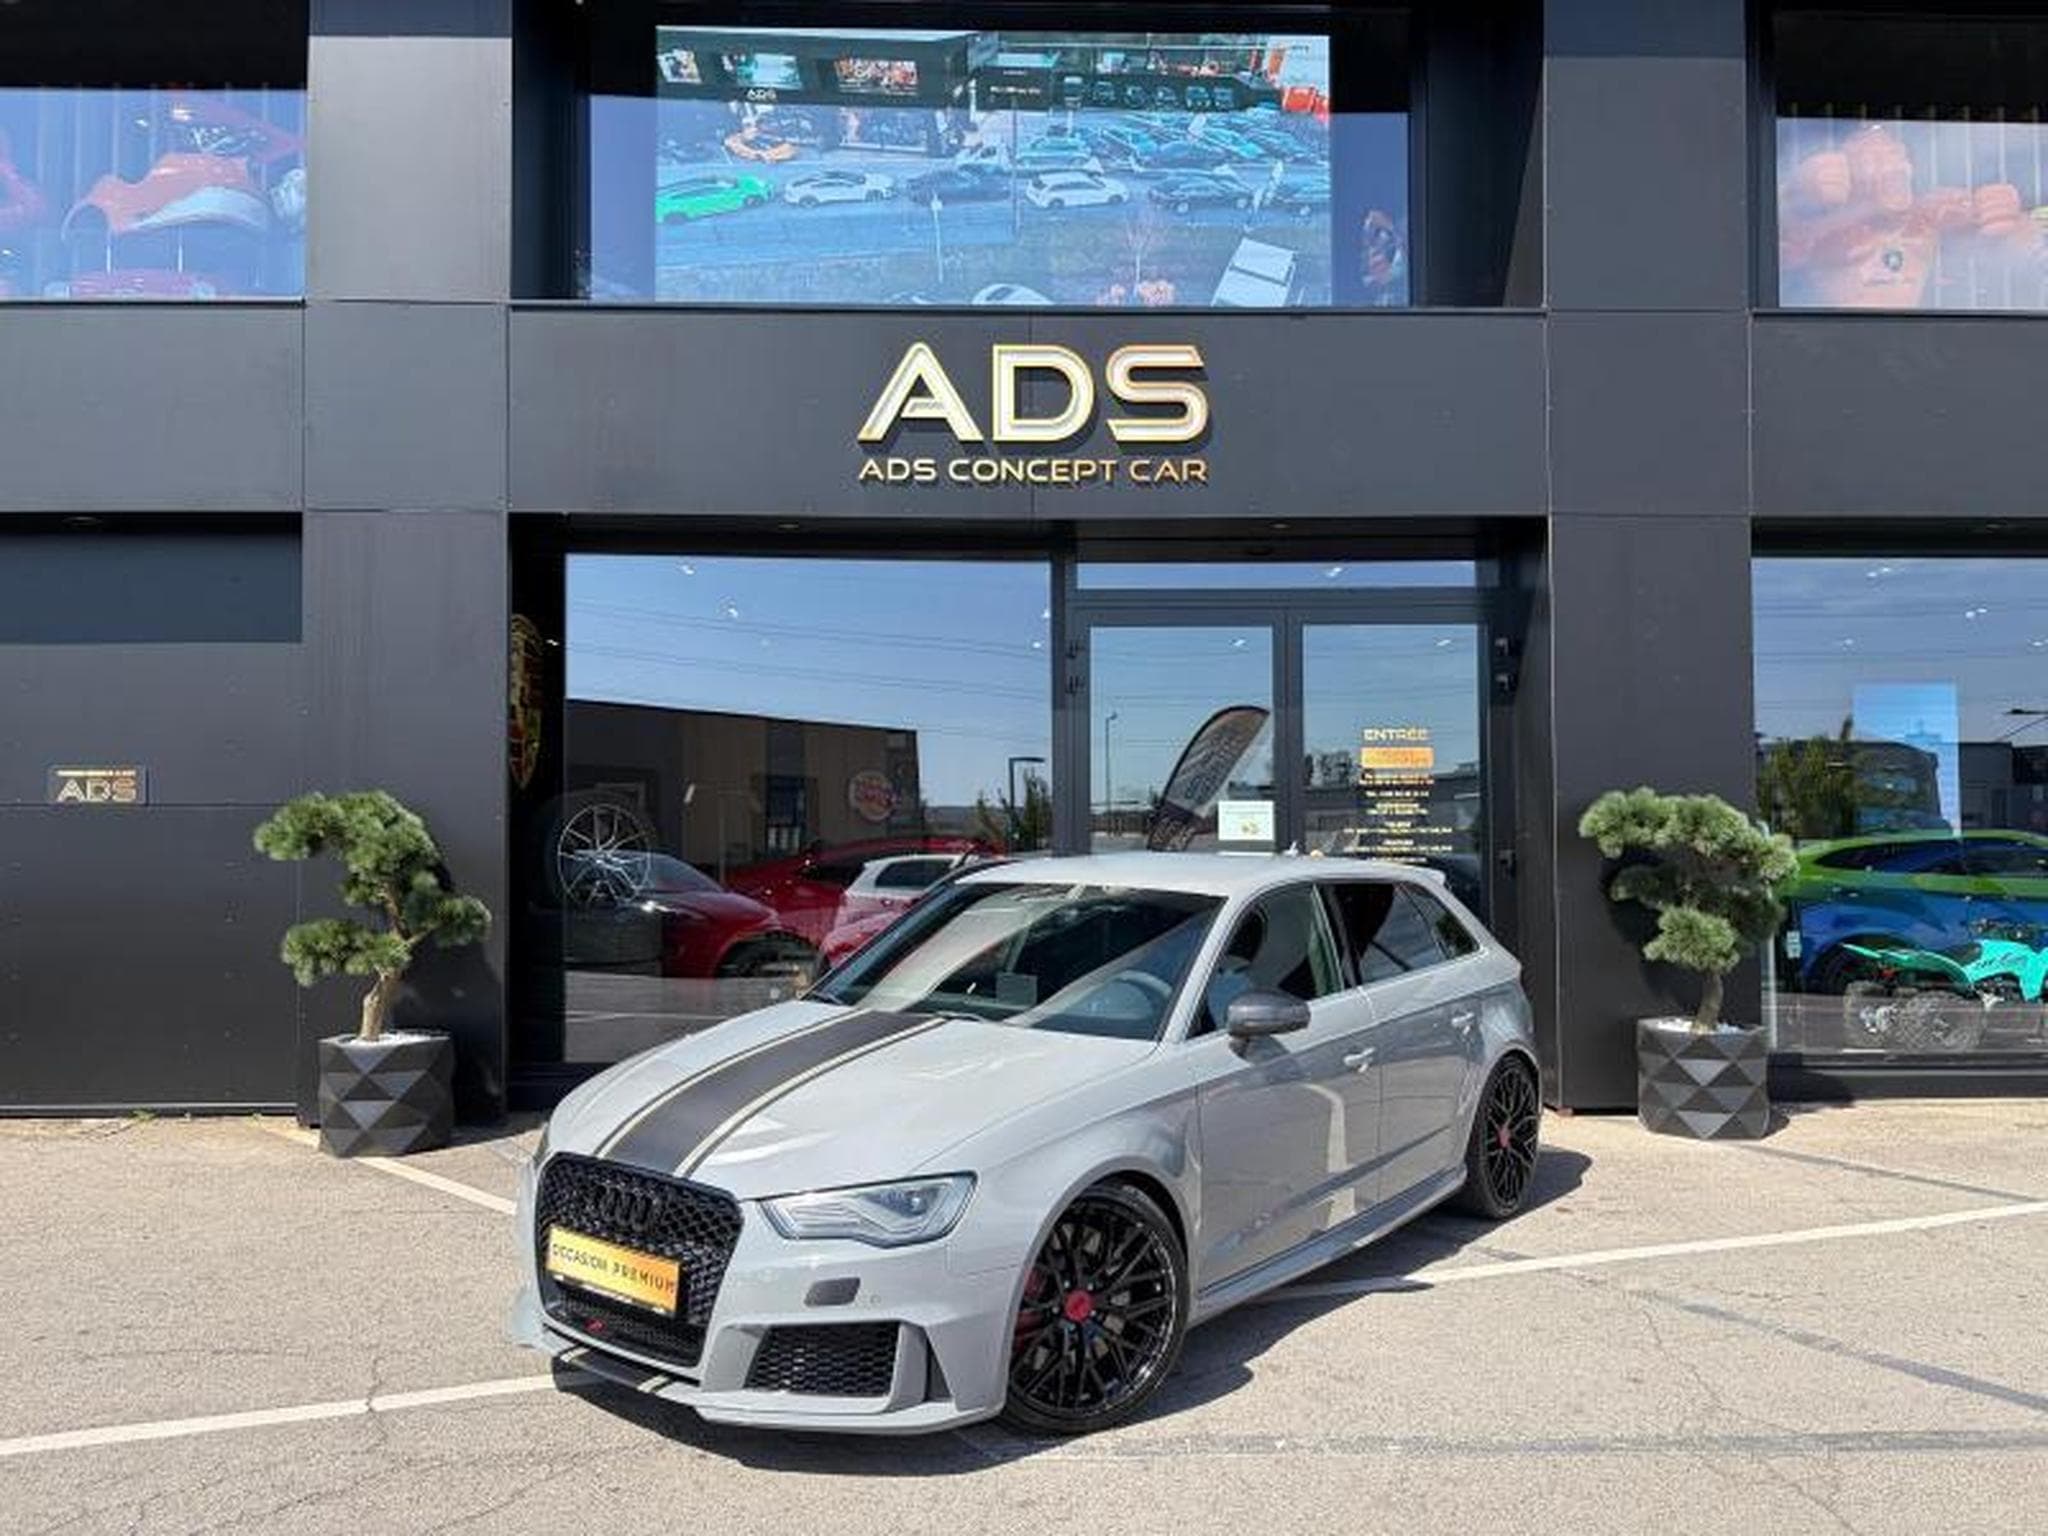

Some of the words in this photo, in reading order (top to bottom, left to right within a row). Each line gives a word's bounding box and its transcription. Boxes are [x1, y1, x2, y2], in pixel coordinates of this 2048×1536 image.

[857, 342, 1209, 442] ADS
[859, 459, 936, 482] ADS
[949, 459, 1118, 483] CONCEPT
[1129, 459, 1208, 482] CAR
[57, 779, 137, 803] ADS
[551, 1242, 608, 1271] OCCASION
[612, 1261, 676, 1294] PREMIUM
